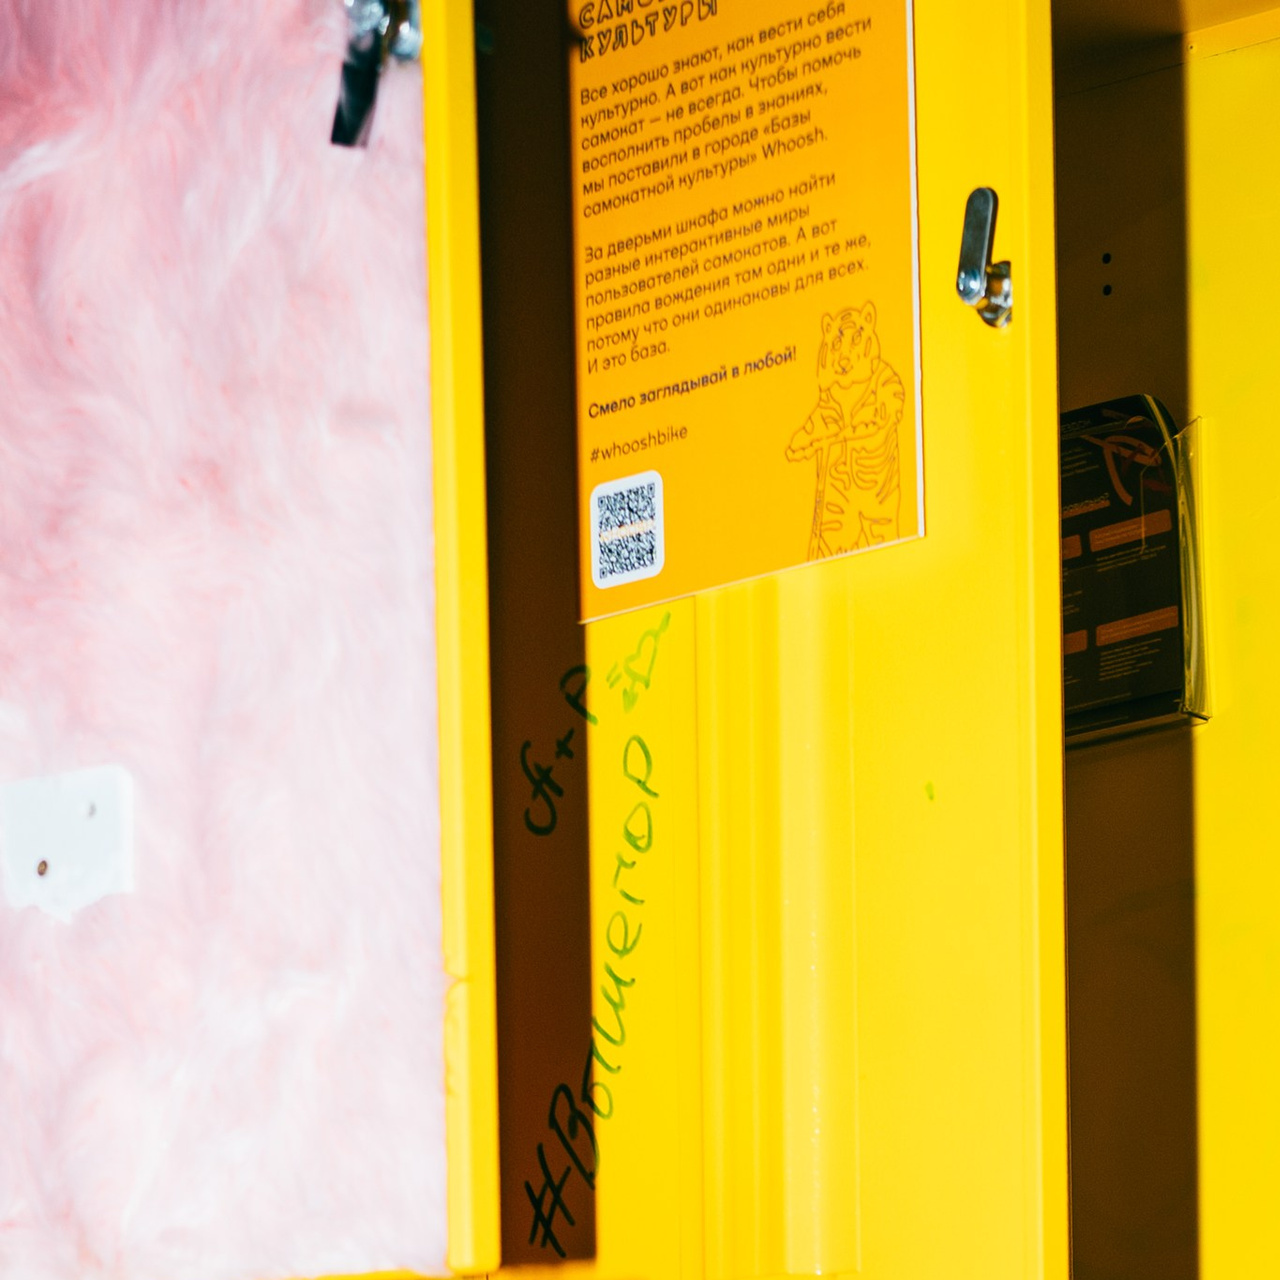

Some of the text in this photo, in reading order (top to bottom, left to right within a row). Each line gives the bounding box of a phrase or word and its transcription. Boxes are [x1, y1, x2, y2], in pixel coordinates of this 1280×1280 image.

[580, 0, 845, 105] Все хорошо знают, как вести себя
[580, 17, 871, 130] культурно. А вот как культурно вести
[581, 47, 861, 151] самокат не всегда. Чтобы помочь
[582, 82, 827, 173] восполнить пробелы знаниях,
[582, 109, 810, 196] мы поставили городе «Базы
[583, 126, 827, 218] самокатной культуры» Whoosh.
[584, 173, 835, 263] За дверьми шкафа можно найти
[585, 205, 809, 290] разные интерактивные миры
[585, 219, 837, 308] пользователей самокатов. А вот
[586, 235, 871, 332] правила вождения там одни и те же,
[586, 260, 867, 352] потому что они одинаковы для всех.
[587, 340, 670, 375] И это база.
[588, 345, 796, 419] Смело заглядывай любой!
[590, 425, 687, 463] #whooshbike
